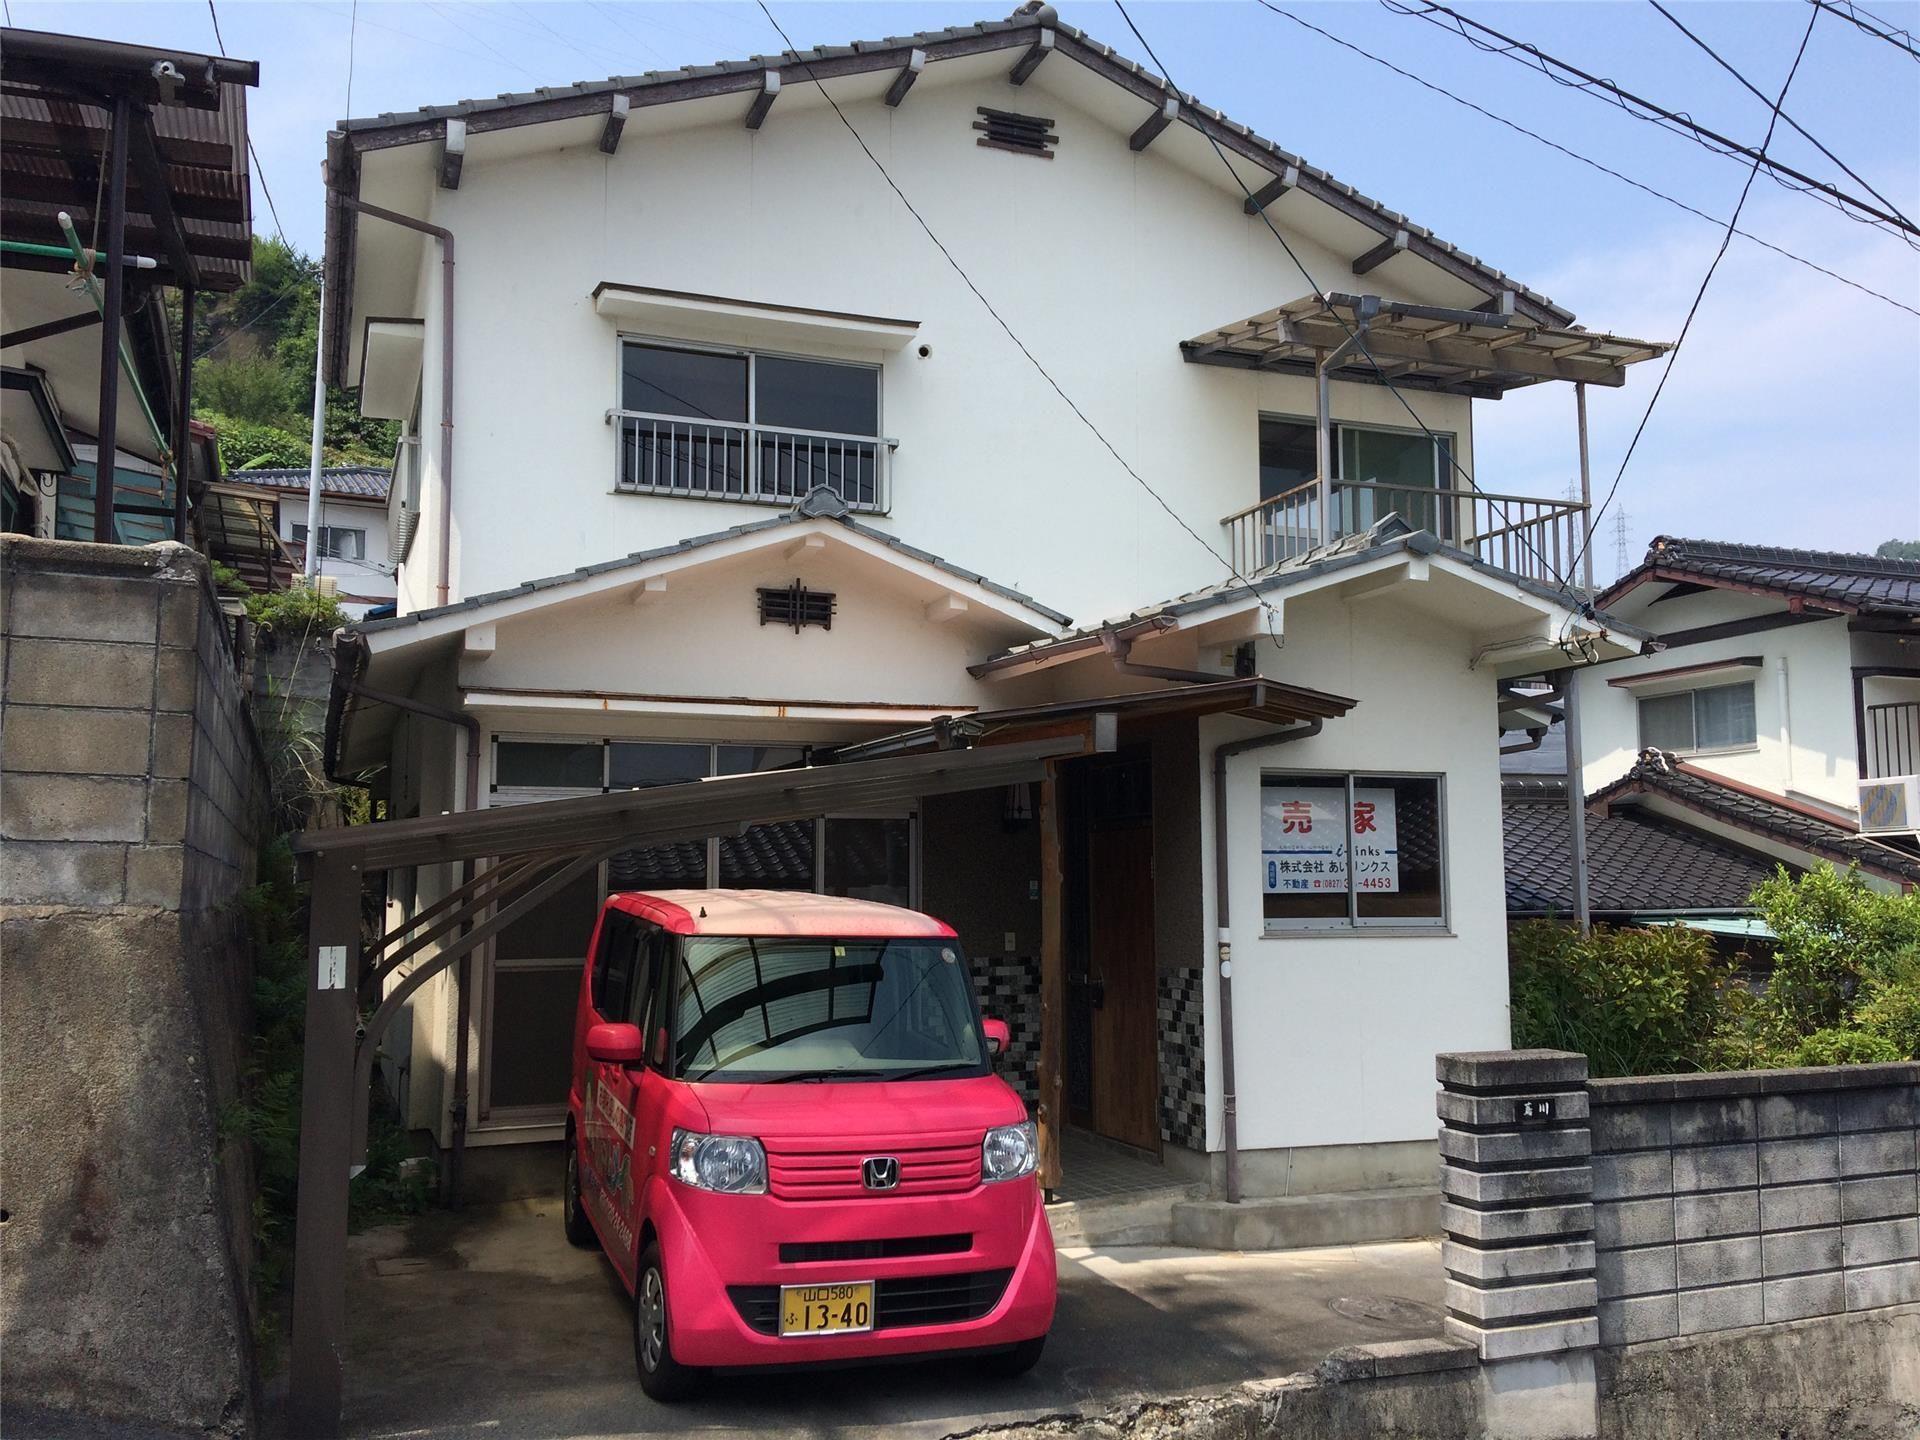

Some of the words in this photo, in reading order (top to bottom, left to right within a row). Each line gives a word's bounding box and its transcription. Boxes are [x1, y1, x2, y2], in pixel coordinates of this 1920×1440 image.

[1280, 860, 1325, 874] 株式会社
[1283, 879, 1309, 889] 不動産
[804, 1302, 868, 1330] 13-40
